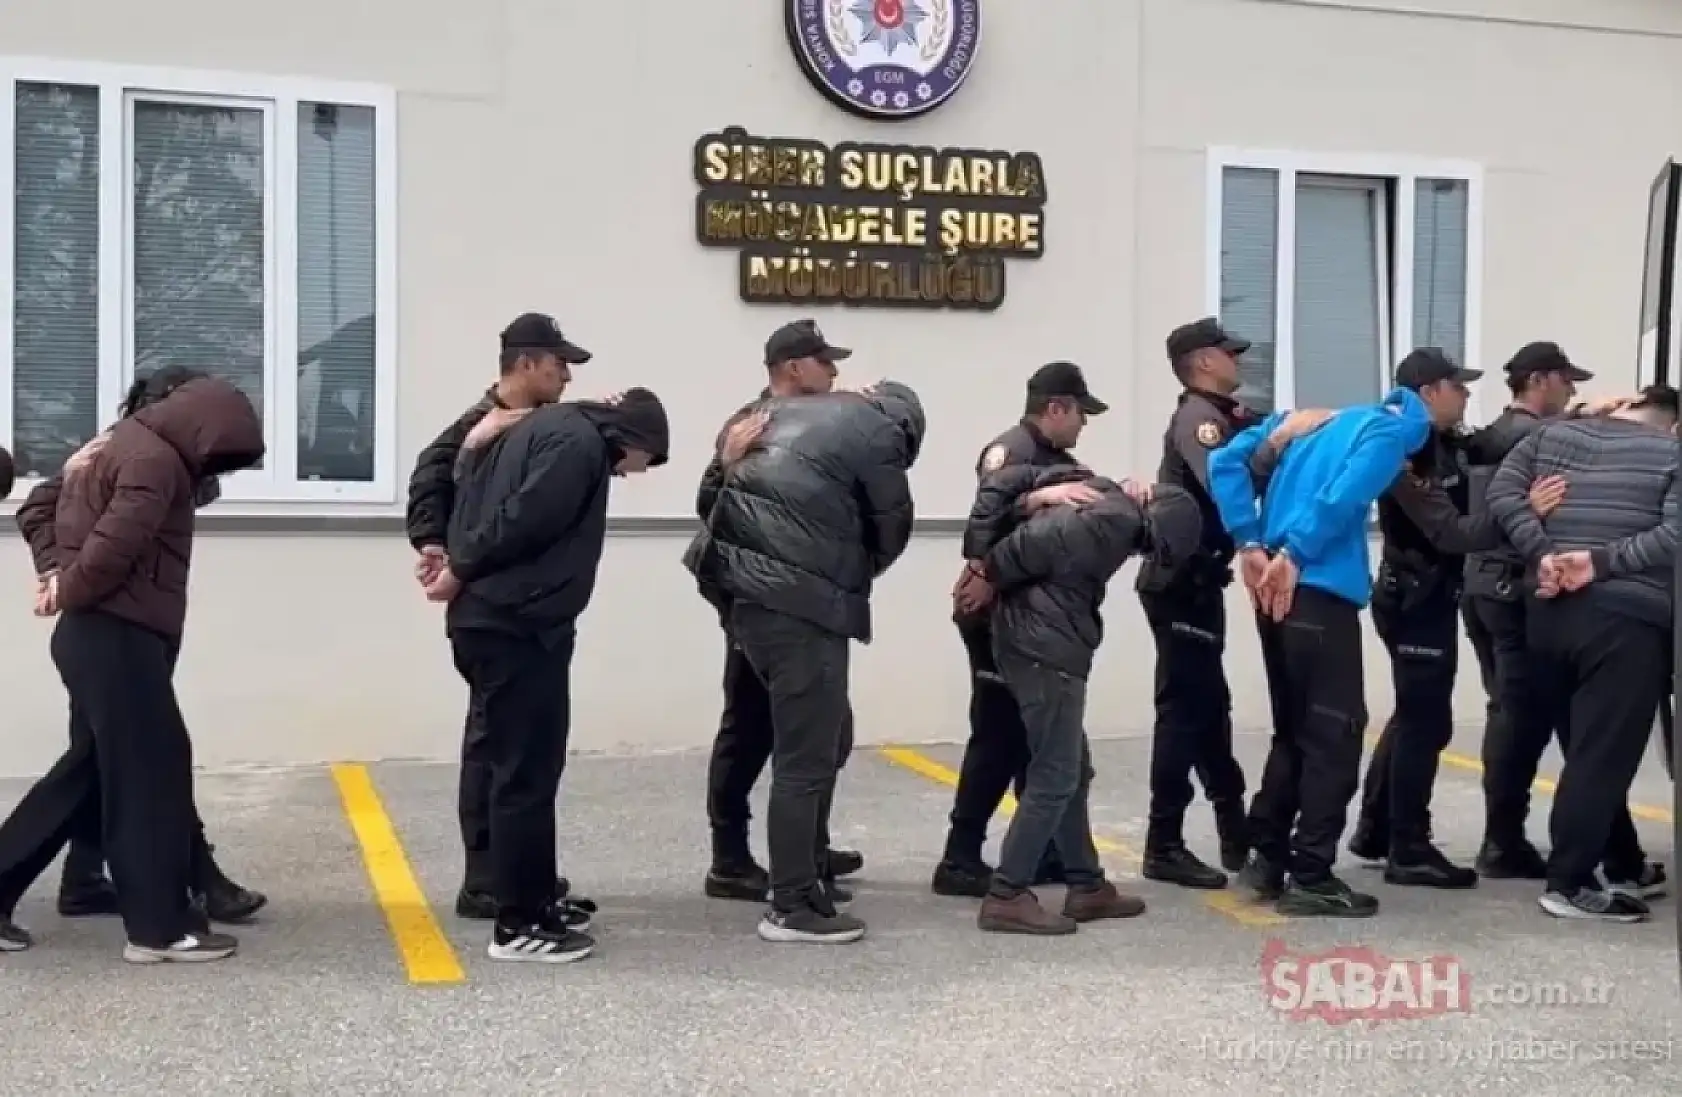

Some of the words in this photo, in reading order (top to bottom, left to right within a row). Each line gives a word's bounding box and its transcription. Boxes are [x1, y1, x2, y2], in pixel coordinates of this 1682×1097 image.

[874, 71, 904, 84] EGM
[704, 133, 826, 186] SİBER
[840, 150, 1040, 201] SUÇLARLA
[706, 190, 927, 246] MÜCADELE
[940, 208, 1039, 256] ŞUBE
[750, 247, 1000, 302] MÜDÜRLÜĞÜ
